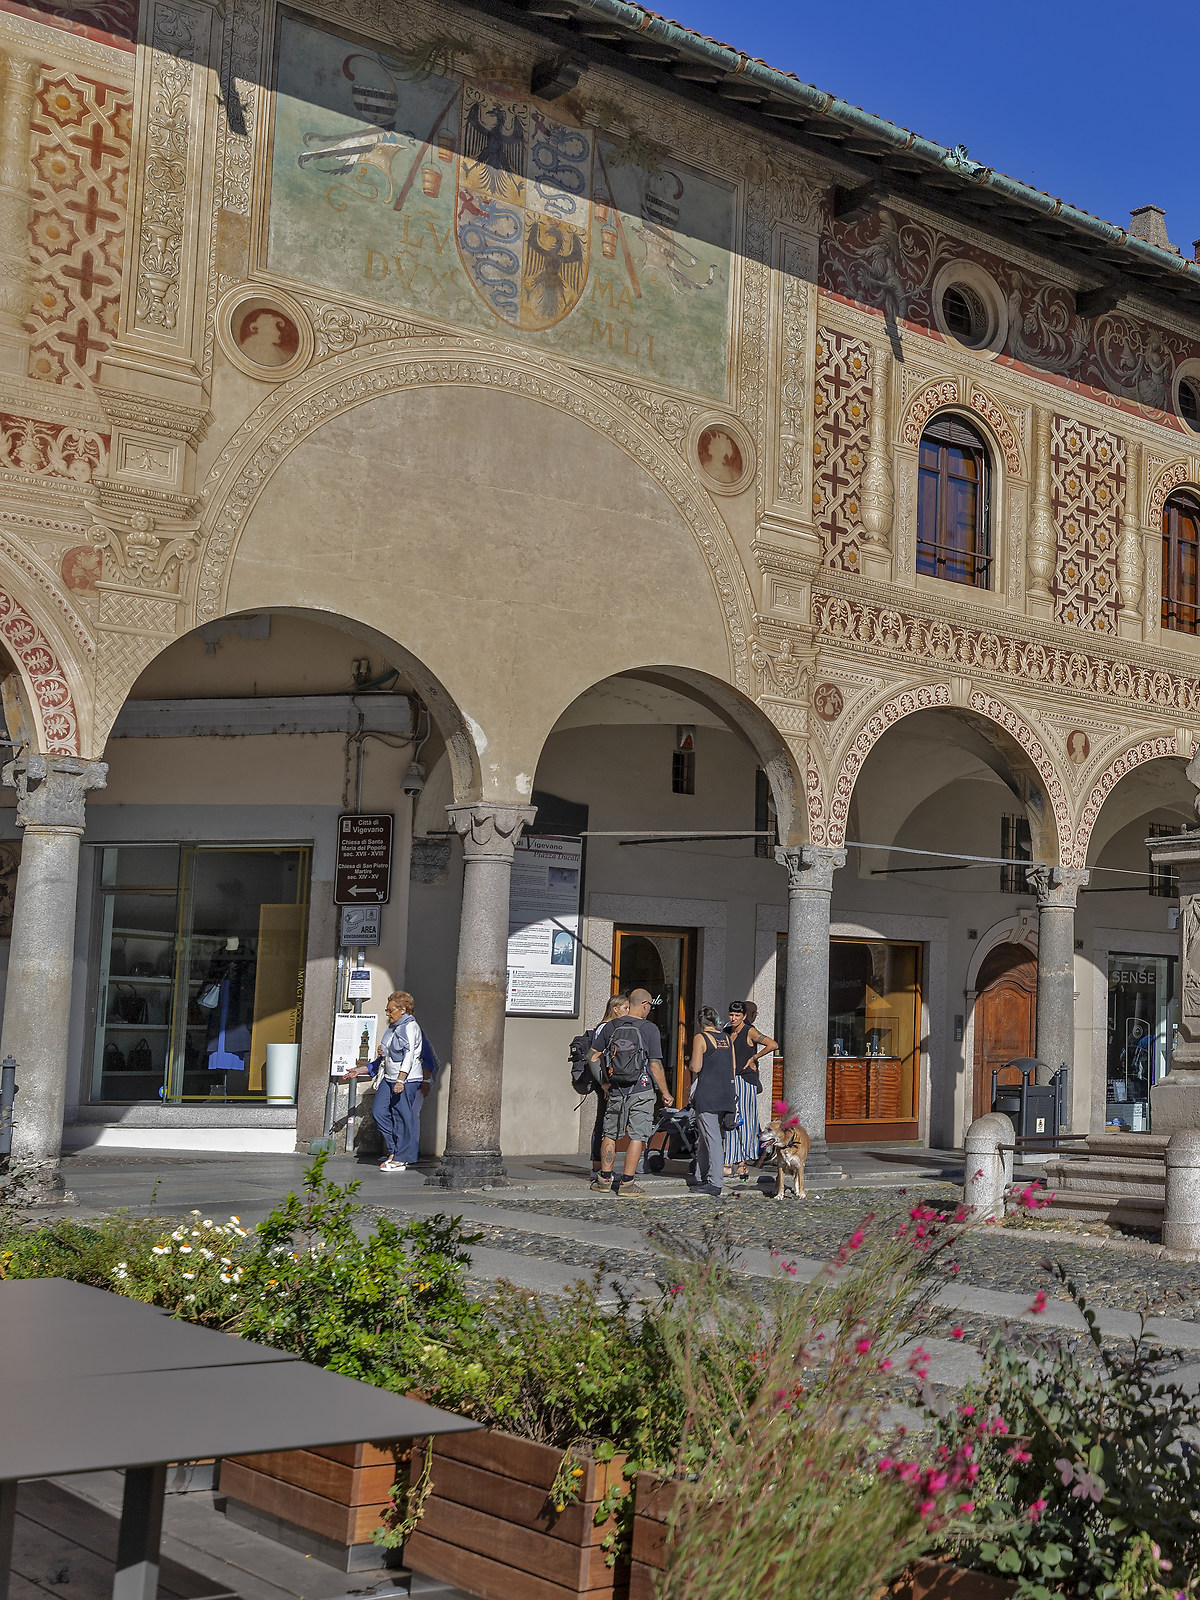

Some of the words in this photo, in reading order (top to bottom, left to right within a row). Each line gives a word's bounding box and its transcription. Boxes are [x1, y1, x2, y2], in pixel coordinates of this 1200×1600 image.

[352, 826, 384, 834] Vigevano
[526, 834, 563, 850] Vigevano
[533, 851, 557, 859] Piazza
[360, 926, 377, 934] AREA
